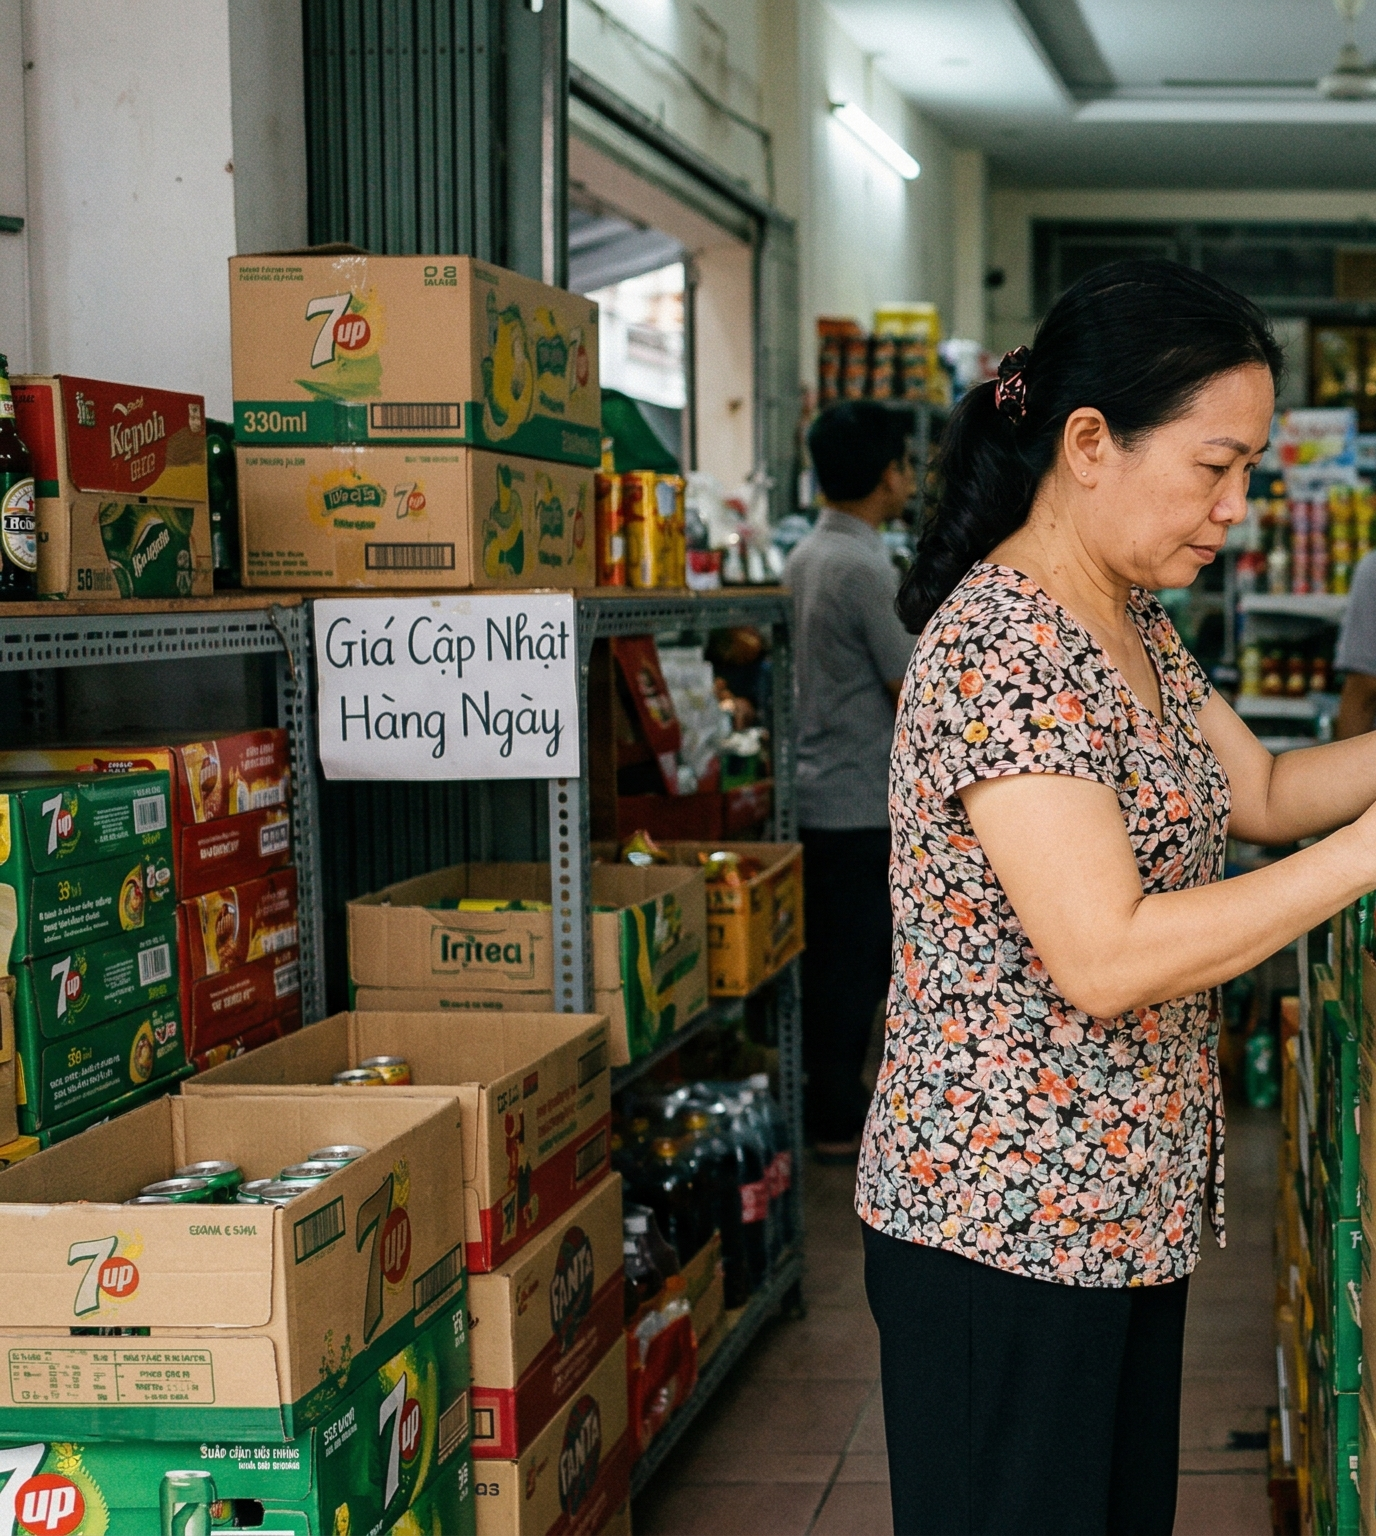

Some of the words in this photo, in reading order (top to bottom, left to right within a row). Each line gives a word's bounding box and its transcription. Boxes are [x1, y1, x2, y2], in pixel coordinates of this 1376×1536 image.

[243, 411, 307, 433] 330ml
[325, 616, 395, 669] Giá
[407, 614, 476, 678] Cập
[485, 611, 570, 671] Nhật
[340, 689, 446, 759] Hàng
[461, 690, 565, 758] Ngày
